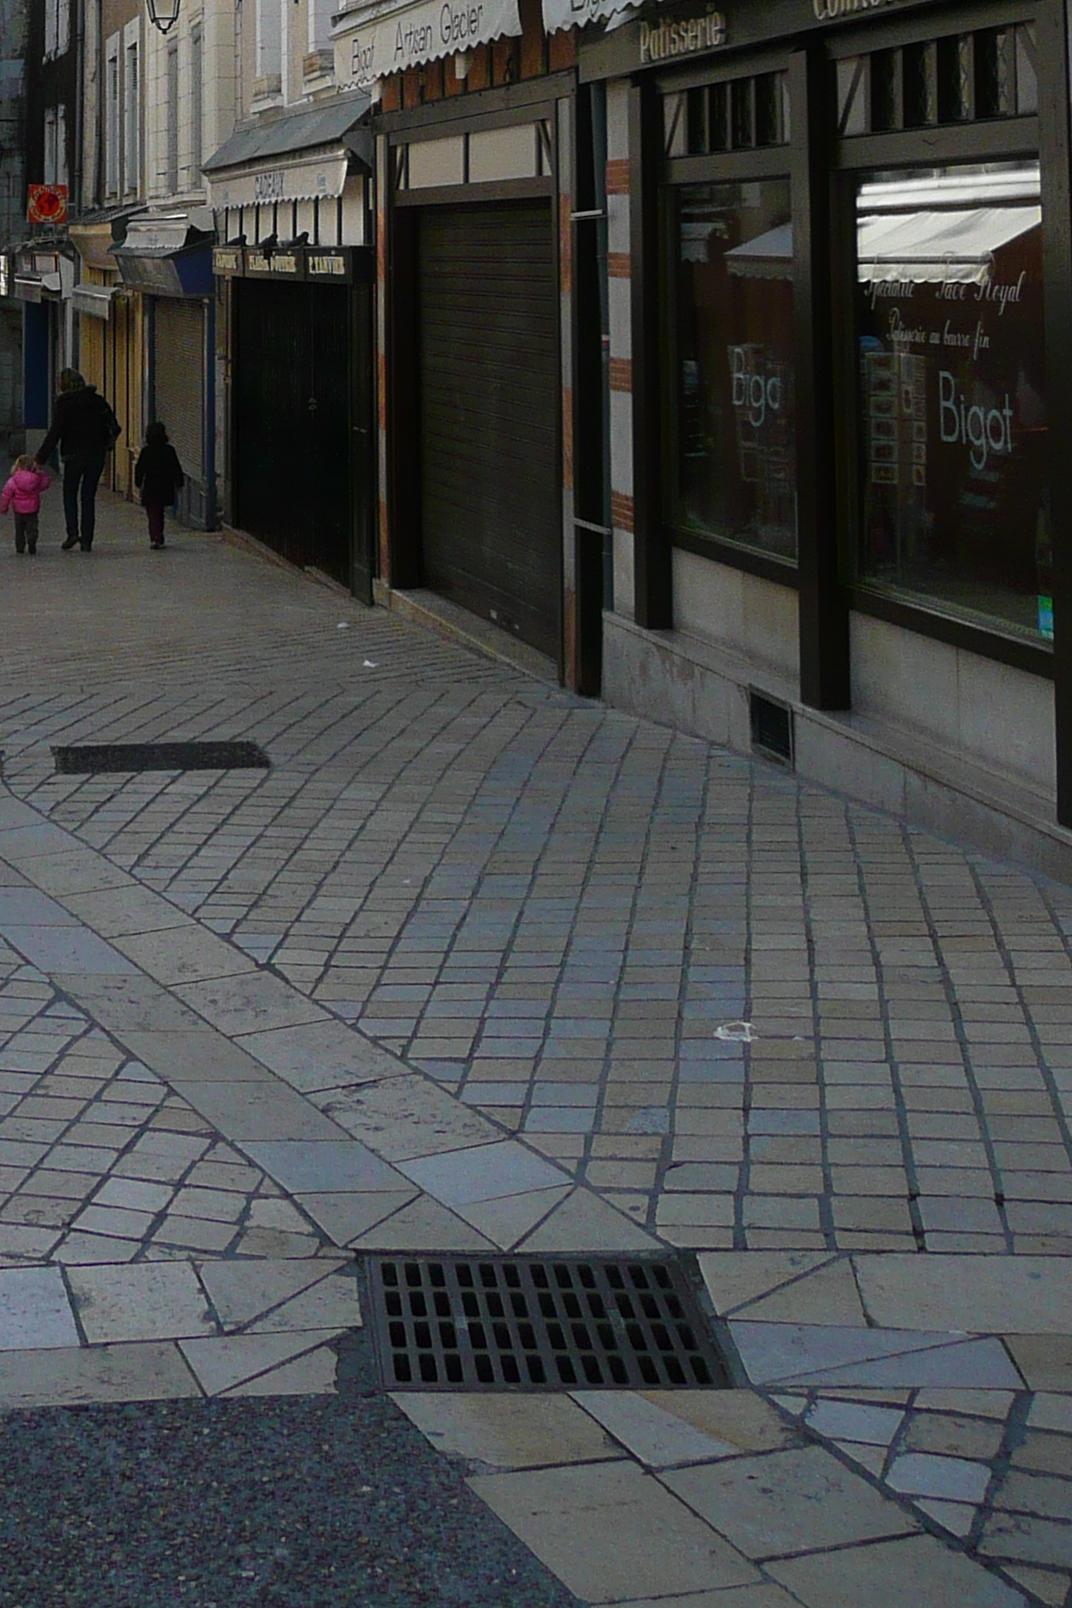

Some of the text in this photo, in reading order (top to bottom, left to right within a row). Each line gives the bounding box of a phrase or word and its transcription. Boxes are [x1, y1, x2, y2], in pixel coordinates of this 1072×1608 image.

[351, 2, 484, 76] Bigot Artisan Glacier
[640, 6, 727, 64] Patisserie
[973, 320, 990, 361] fin
[939, 370, 1013, 470] Bigot
